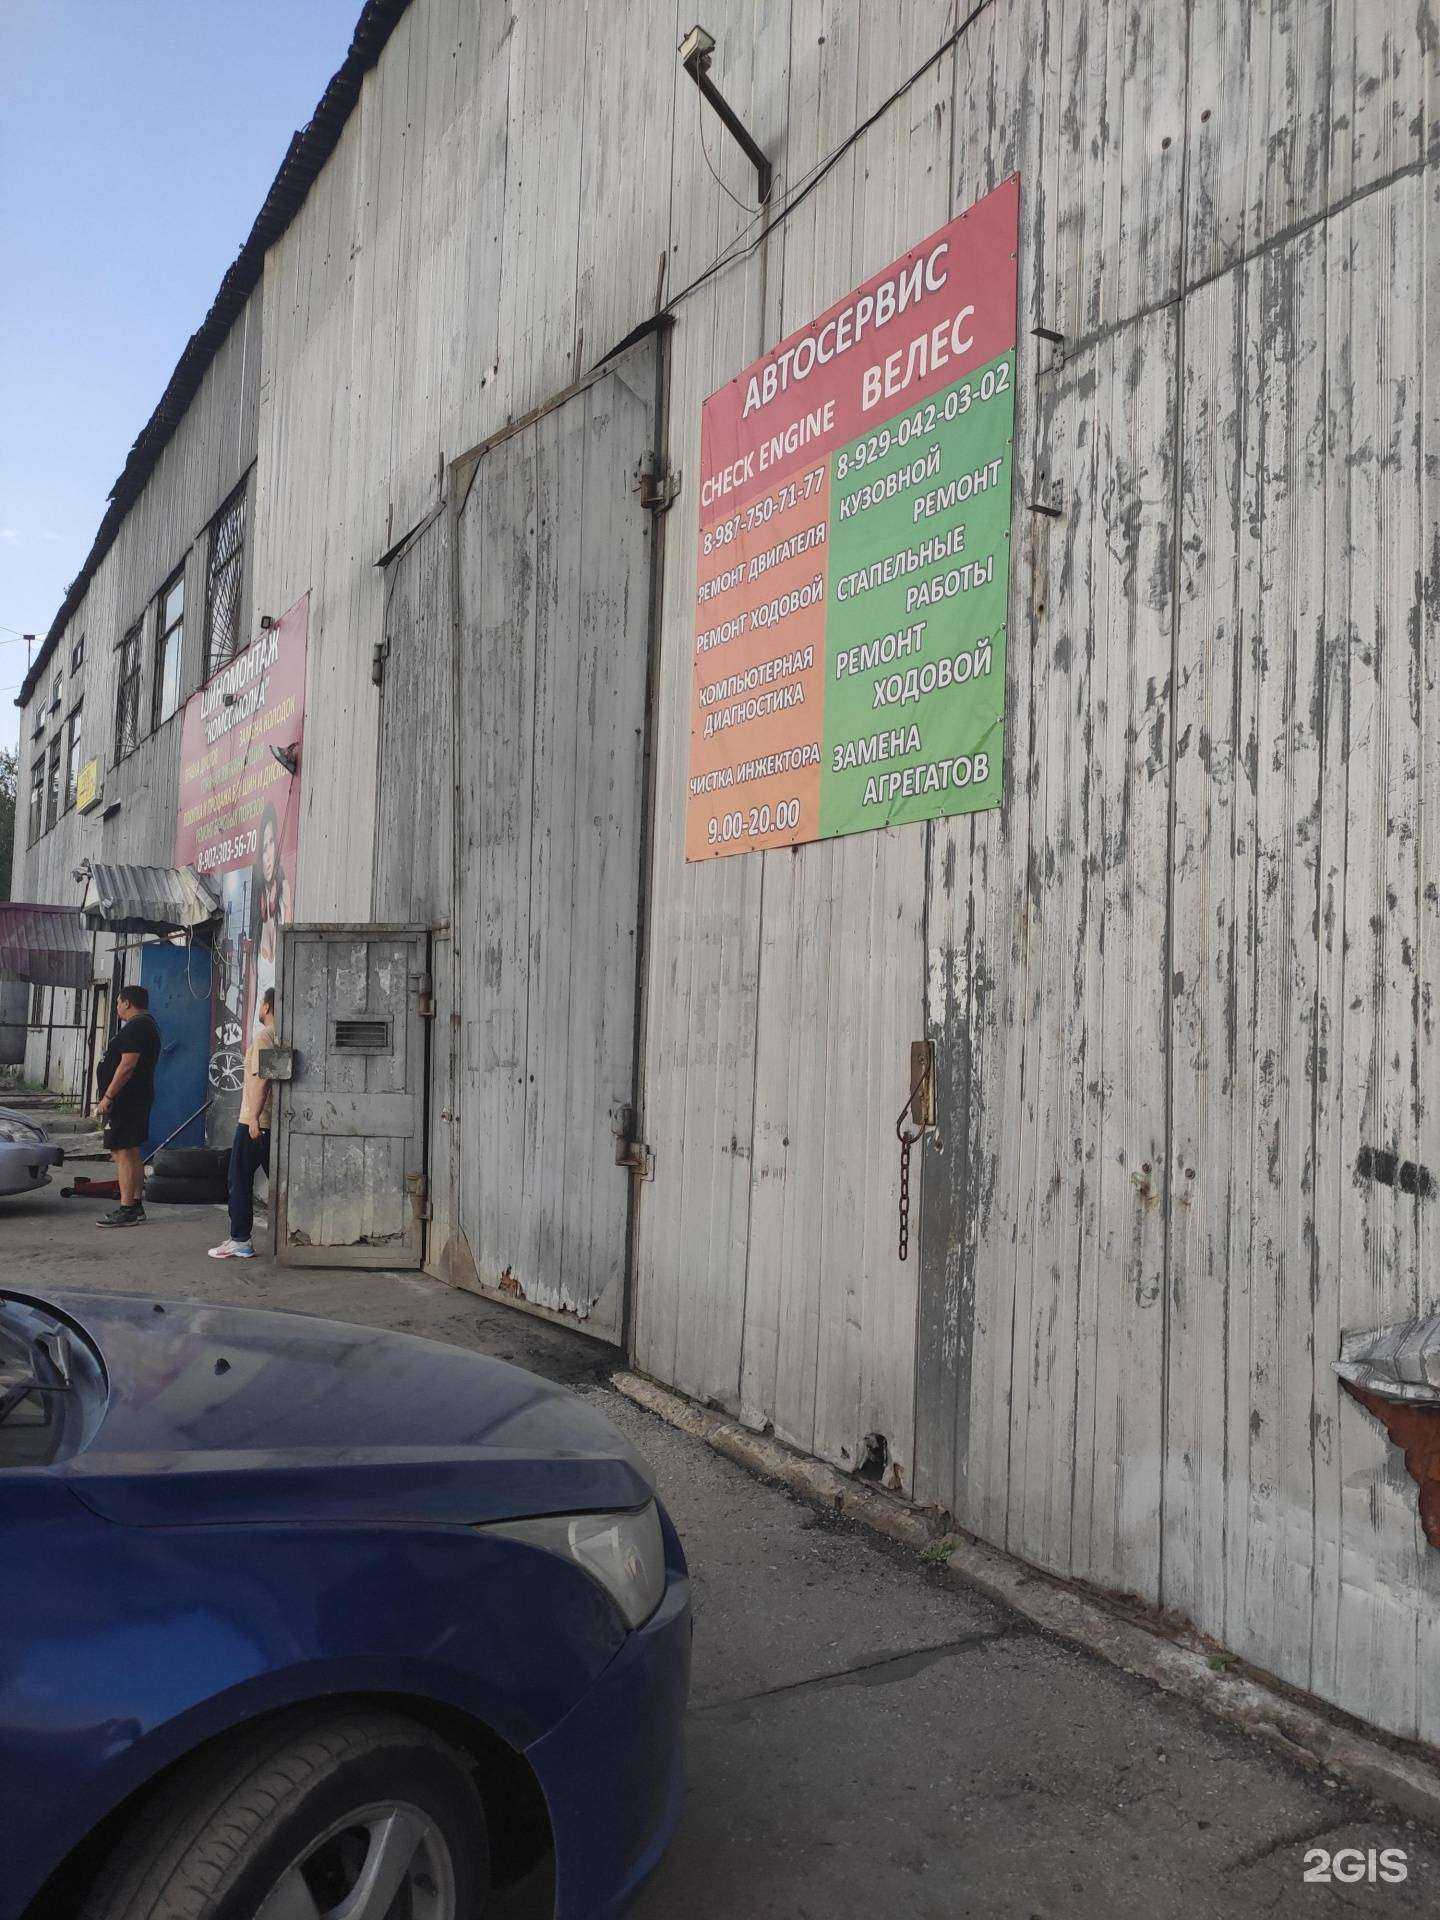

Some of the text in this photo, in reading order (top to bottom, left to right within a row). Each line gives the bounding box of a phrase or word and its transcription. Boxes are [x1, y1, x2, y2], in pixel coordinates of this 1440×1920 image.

[742, 243, 949, 419] АВТОСЕРВИС
[861, 305, 975, 412] ВЕЛЕС
[701, 400, 836, 508] CHECK ENGINE
[836, 361, 1010, 481] 8-929-042-03-02
[703, 466, 826, 556] 8-987-750-71-77
[839, 443, 941, 521] КУЗОВНОЙ
[913, 458, 1003, 524] РЕМОНТ
[697, 521, 827, 605] РЕМОНТ ДВИГАТЕЛЯ
[836, 524, 966, 602] СТАПЕЛЬНЫЕ
[905, 555, 994, 614] РАБОТЫ
[695, 573, 824, 654] РЕМОНТ ХОДОВОЙ
[835, 620, 928, 680] РЕМОНТ
[200, 628, 280, 720] ШИНОМОНТАЖ
[699, 643, 815, 708] КОМПЬЮТЕРНАЯ
[872, 636, 993, 710] ХОДОВОЙ
[703, 682, 805, 740] ДИАГНОСТИКА
[831, 723, 922, 773] ЗАМЕНА
[689, 742, 821, 796] ЧИСТКА ИНЖЕКТОРА
[861, 752, 990, 808] АГРЕГАТОВ
[197, 829, 256, 872] 8-902-303-56-70
[707, 797, 801, 845] 9.00-20.00
